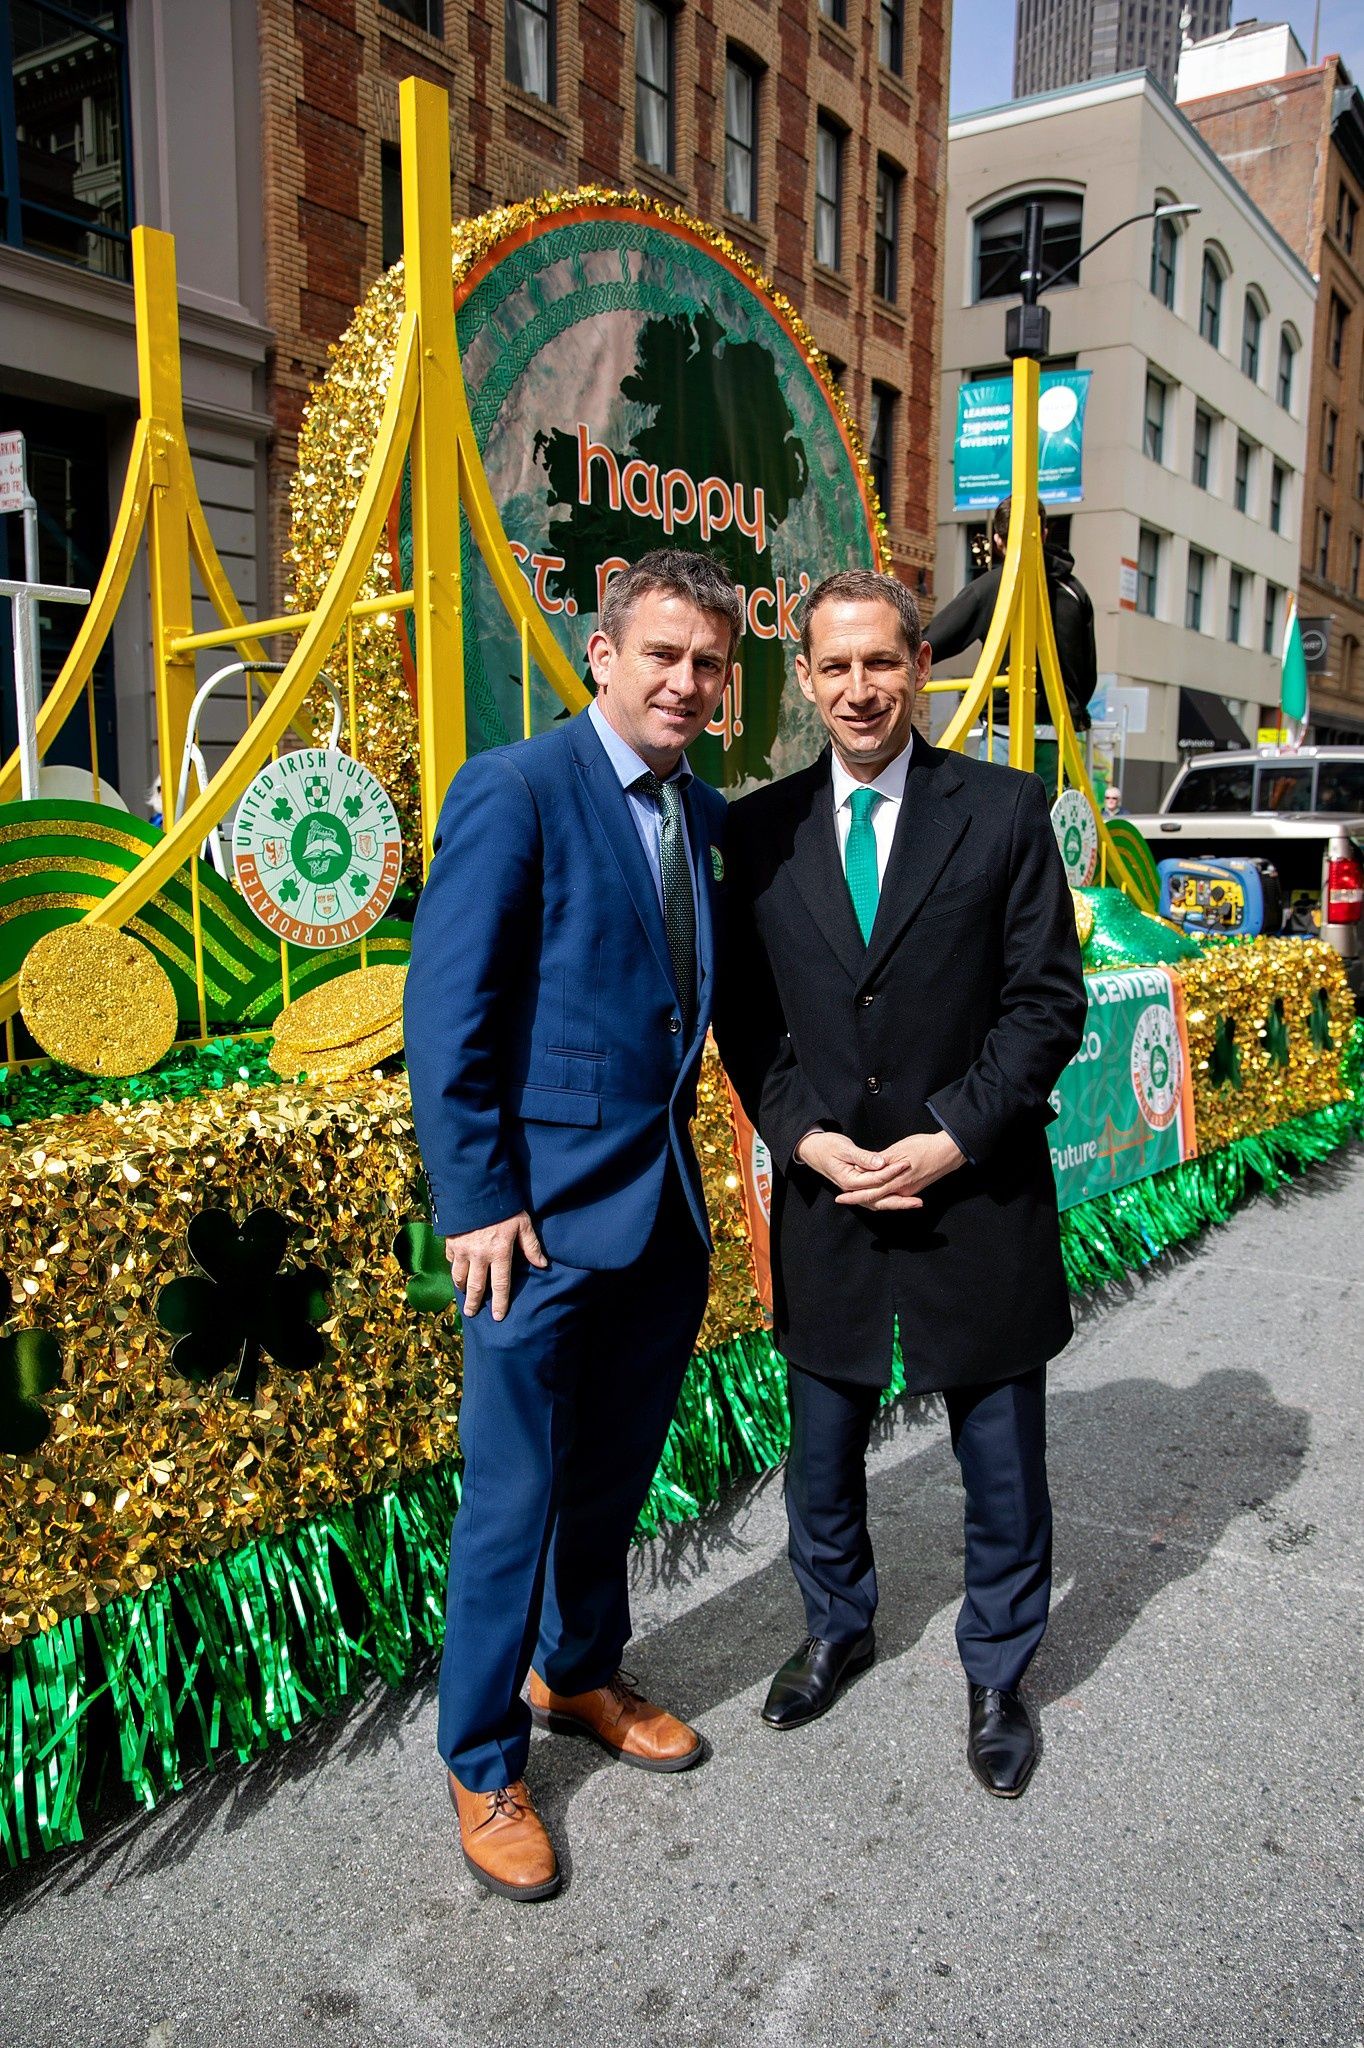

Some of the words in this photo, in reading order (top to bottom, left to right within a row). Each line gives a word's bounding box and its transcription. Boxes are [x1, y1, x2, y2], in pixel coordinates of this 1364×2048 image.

[962, 420, 1008, 433] THROUGH
[964, 404, 1011, 419] LEARNING
[960, 434, 1011, 448] DIVERSITY
[576, 422, 766, 554] happy
[236, 774, 275, 847] UNITED
[278, 752, 327, 777] IRISH
[337, 757, 397, 837] CULTURAL
[364, 849, 399, 920] CENTER
[239, 862, 360, 945] INCORPORATED
[1087, 971, 1167, 1006] CENTER
[1050, 1140, 1098, 1171] Future
